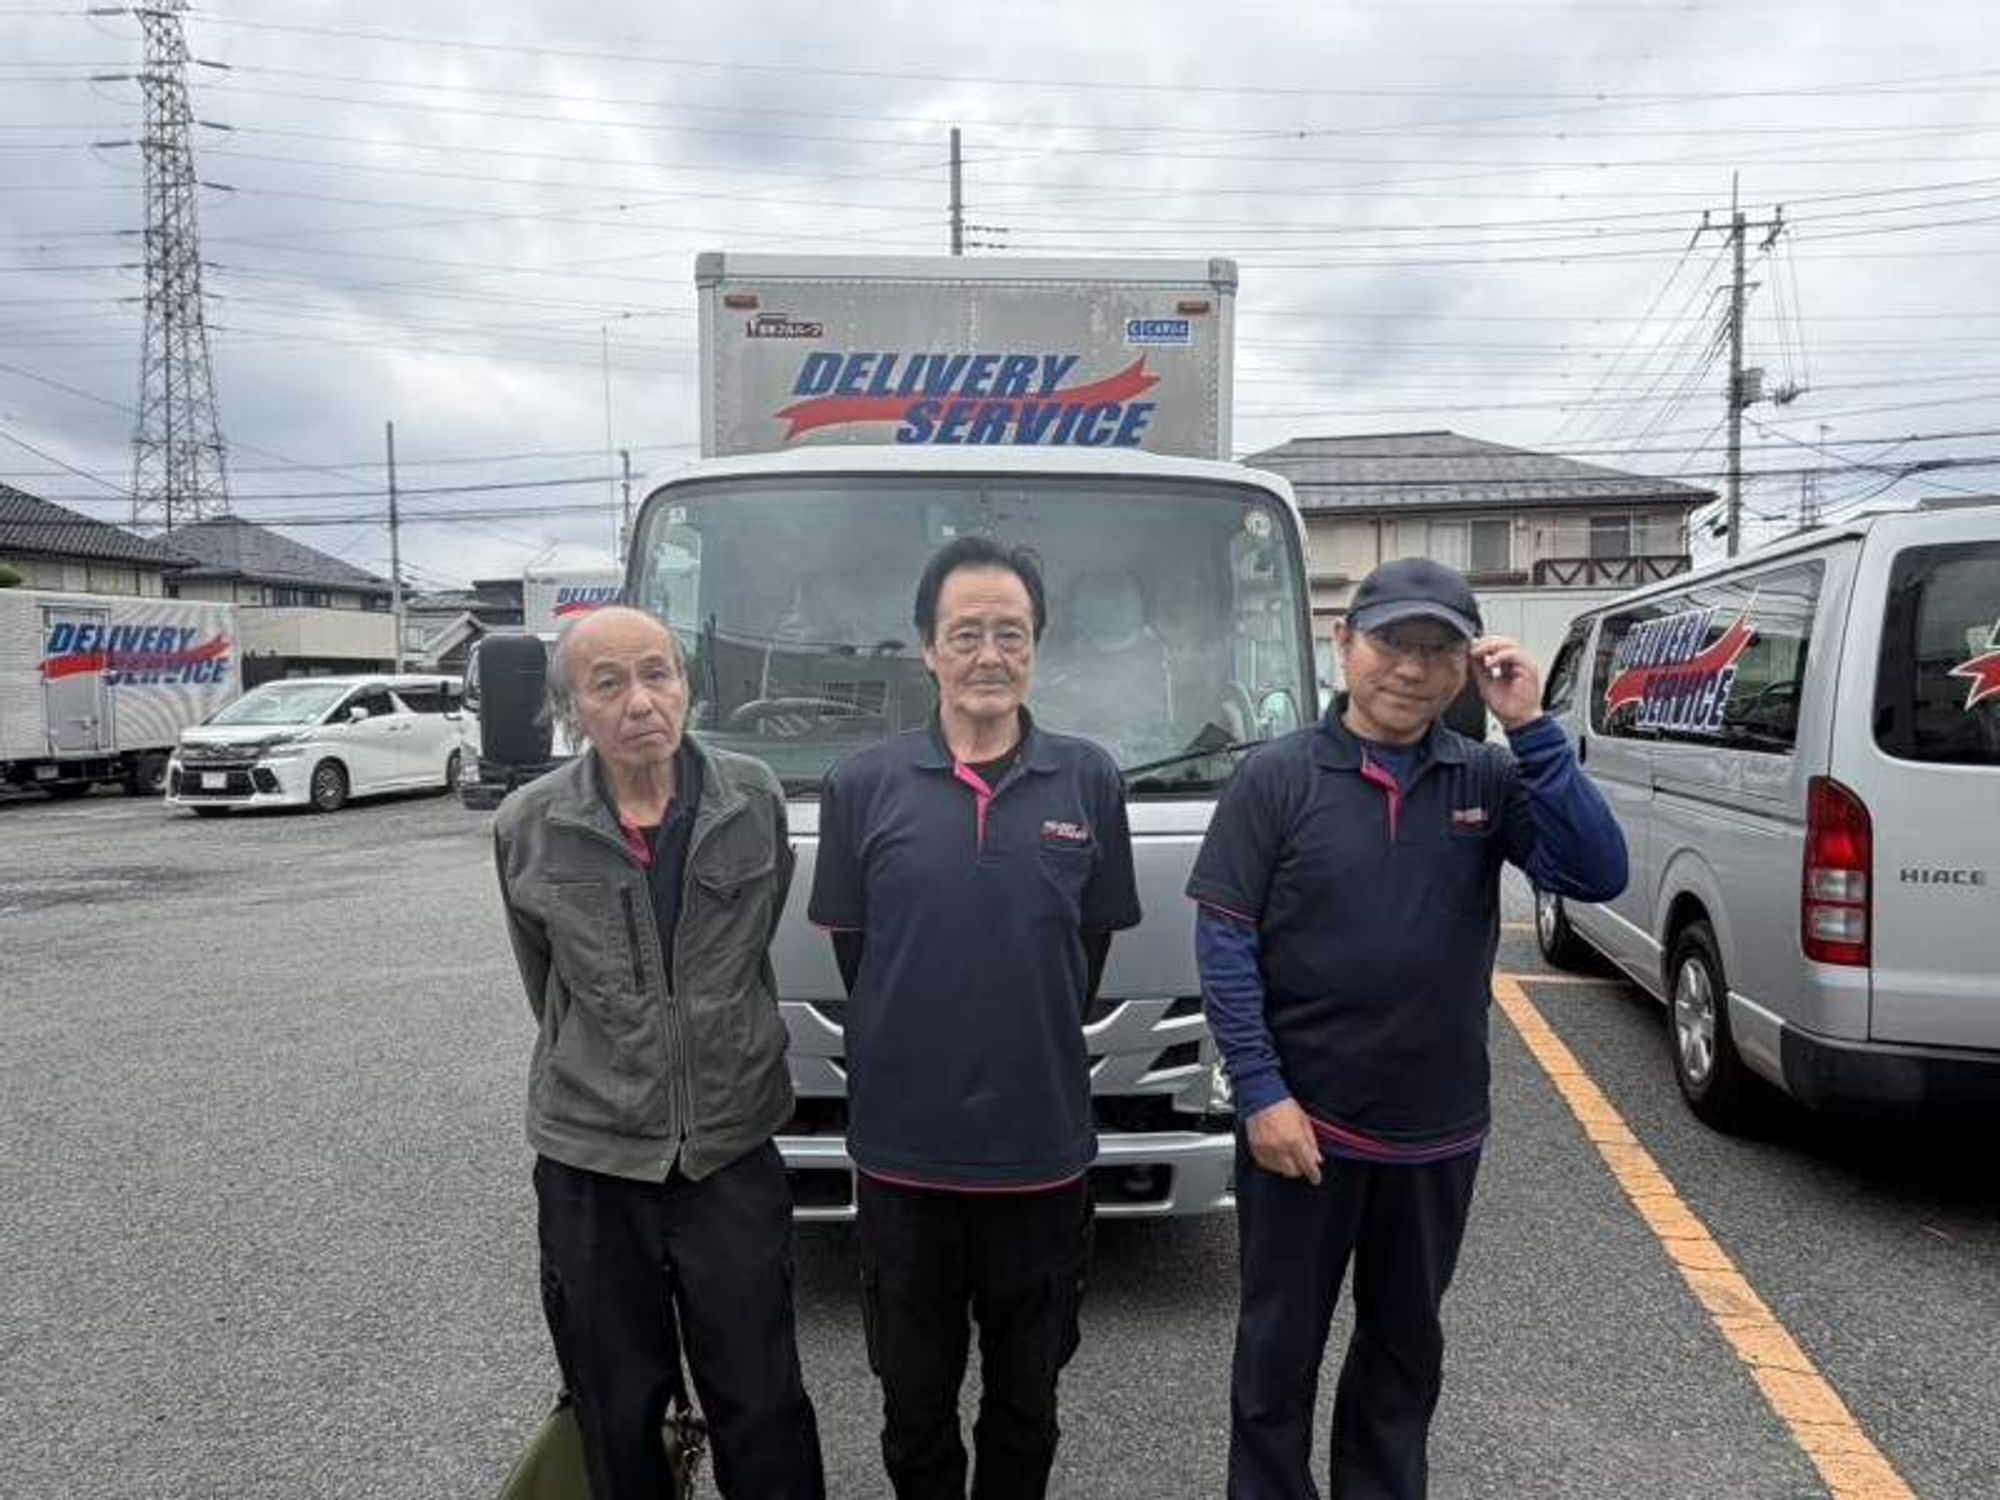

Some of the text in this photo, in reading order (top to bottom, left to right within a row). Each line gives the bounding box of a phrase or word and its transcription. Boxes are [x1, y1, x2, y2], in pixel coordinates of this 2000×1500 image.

[792, 352, 1080, 397] DELIVERY
[895, 401, 1156, 446] SERVICE
[47, 622, 197, 654] DELIVERY
[1617, 606, 1721, 671] DELIVERY
[1635, 666, 1738, 731] SERVICE
[1900, 869, 1986, 886] HIACE
